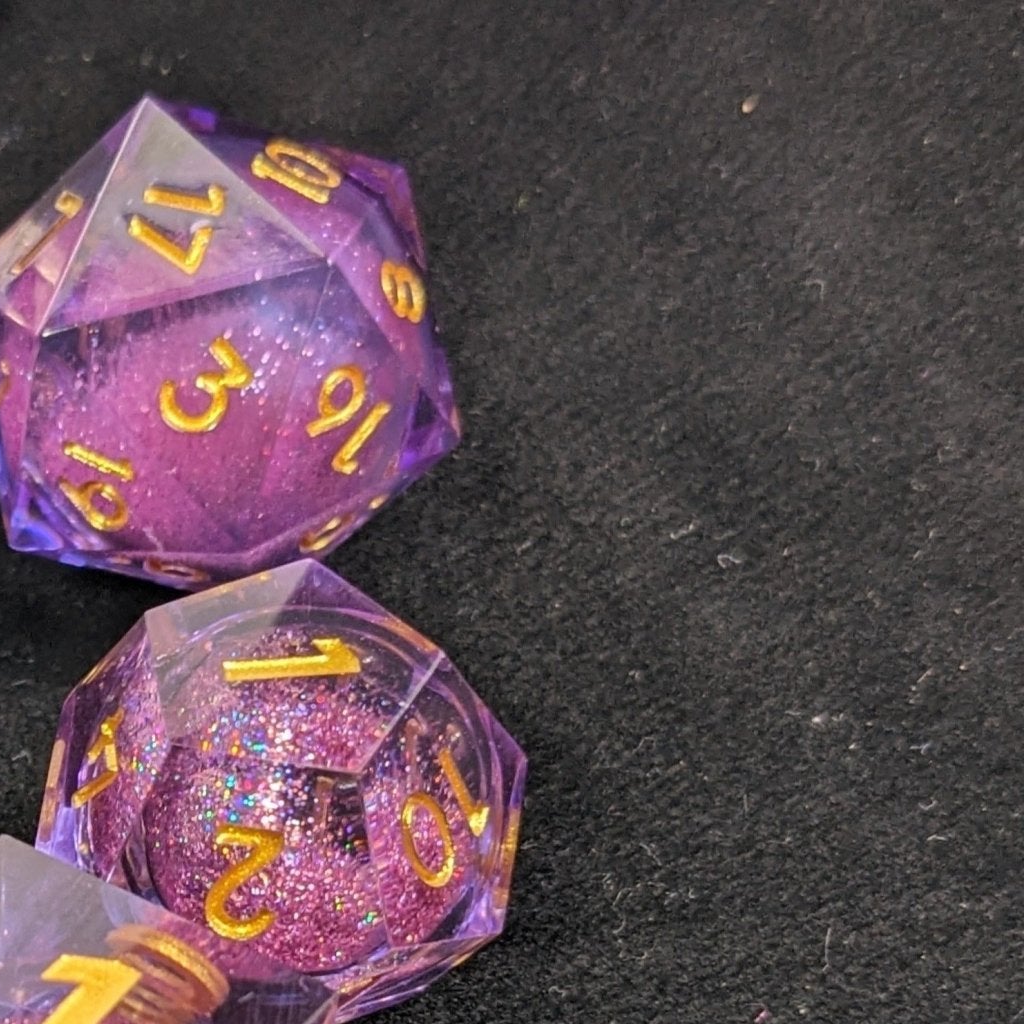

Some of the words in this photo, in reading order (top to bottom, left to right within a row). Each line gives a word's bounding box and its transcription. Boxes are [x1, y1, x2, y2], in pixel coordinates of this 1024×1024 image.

[250, 137, 342, 204] 10
[127, 183, 226, 275] 17
[159, 336, 253, 433] 3
[222, 637, 362, 684] 1
[204, 825, 284, 941] 2
